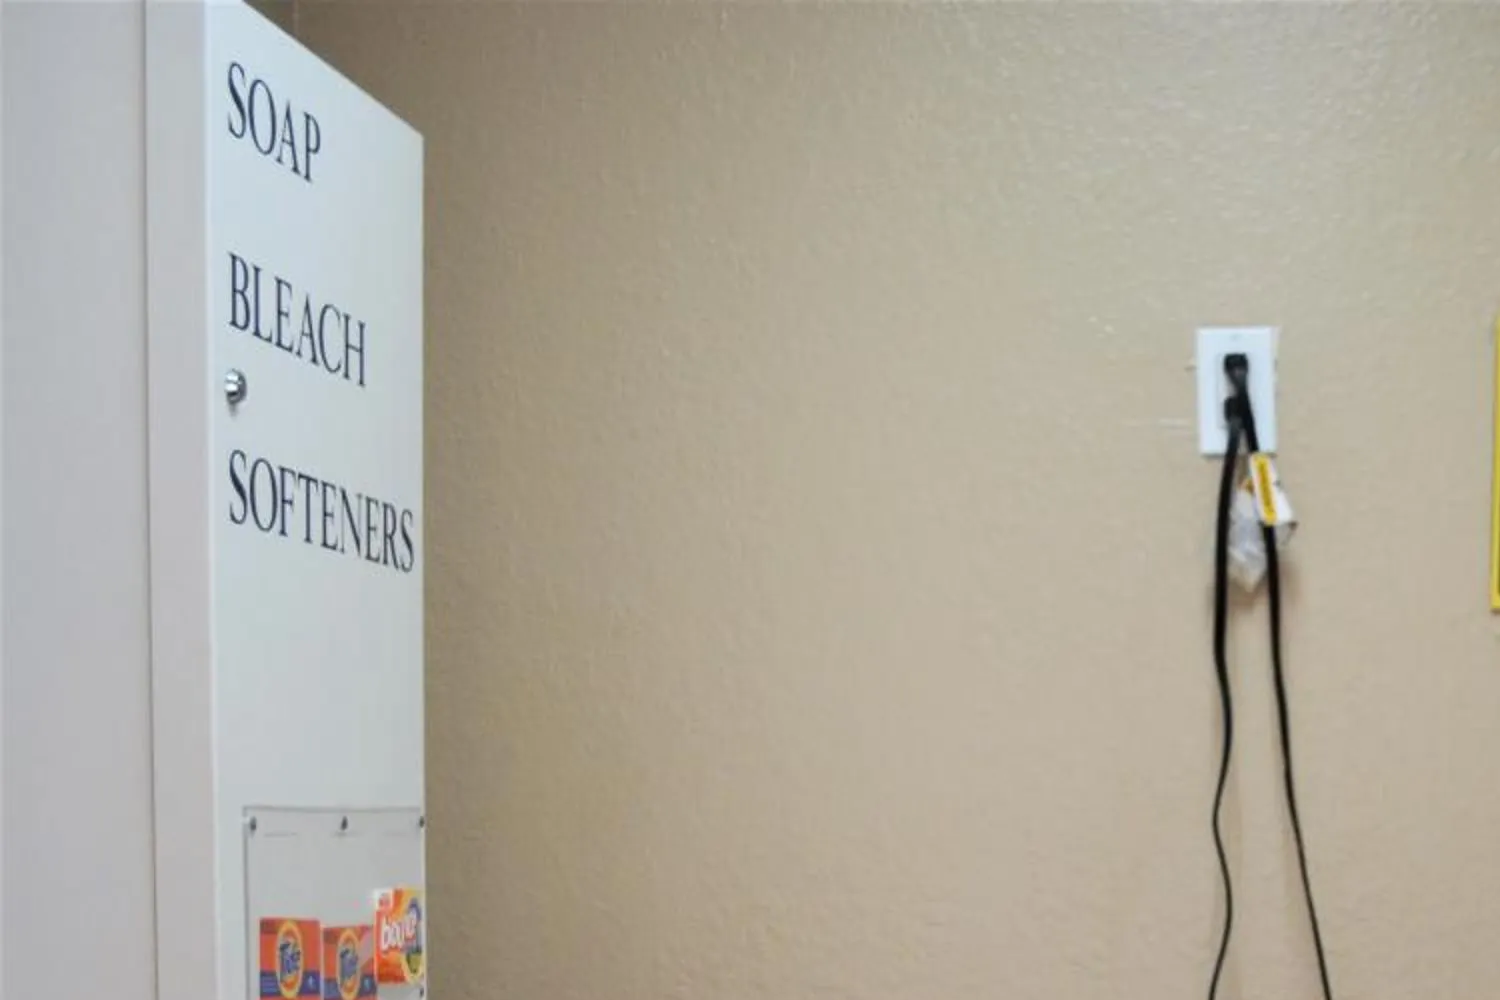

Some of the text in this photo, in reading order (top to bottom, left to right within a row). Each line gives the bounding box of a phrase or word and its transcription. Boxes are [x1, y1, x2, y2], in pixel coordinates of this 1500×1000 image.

[227, 60, 321, 183] SOAP
[228, 252, 366, 388] BLEACH
[228, 449, 415, 574] SOFTENERS
